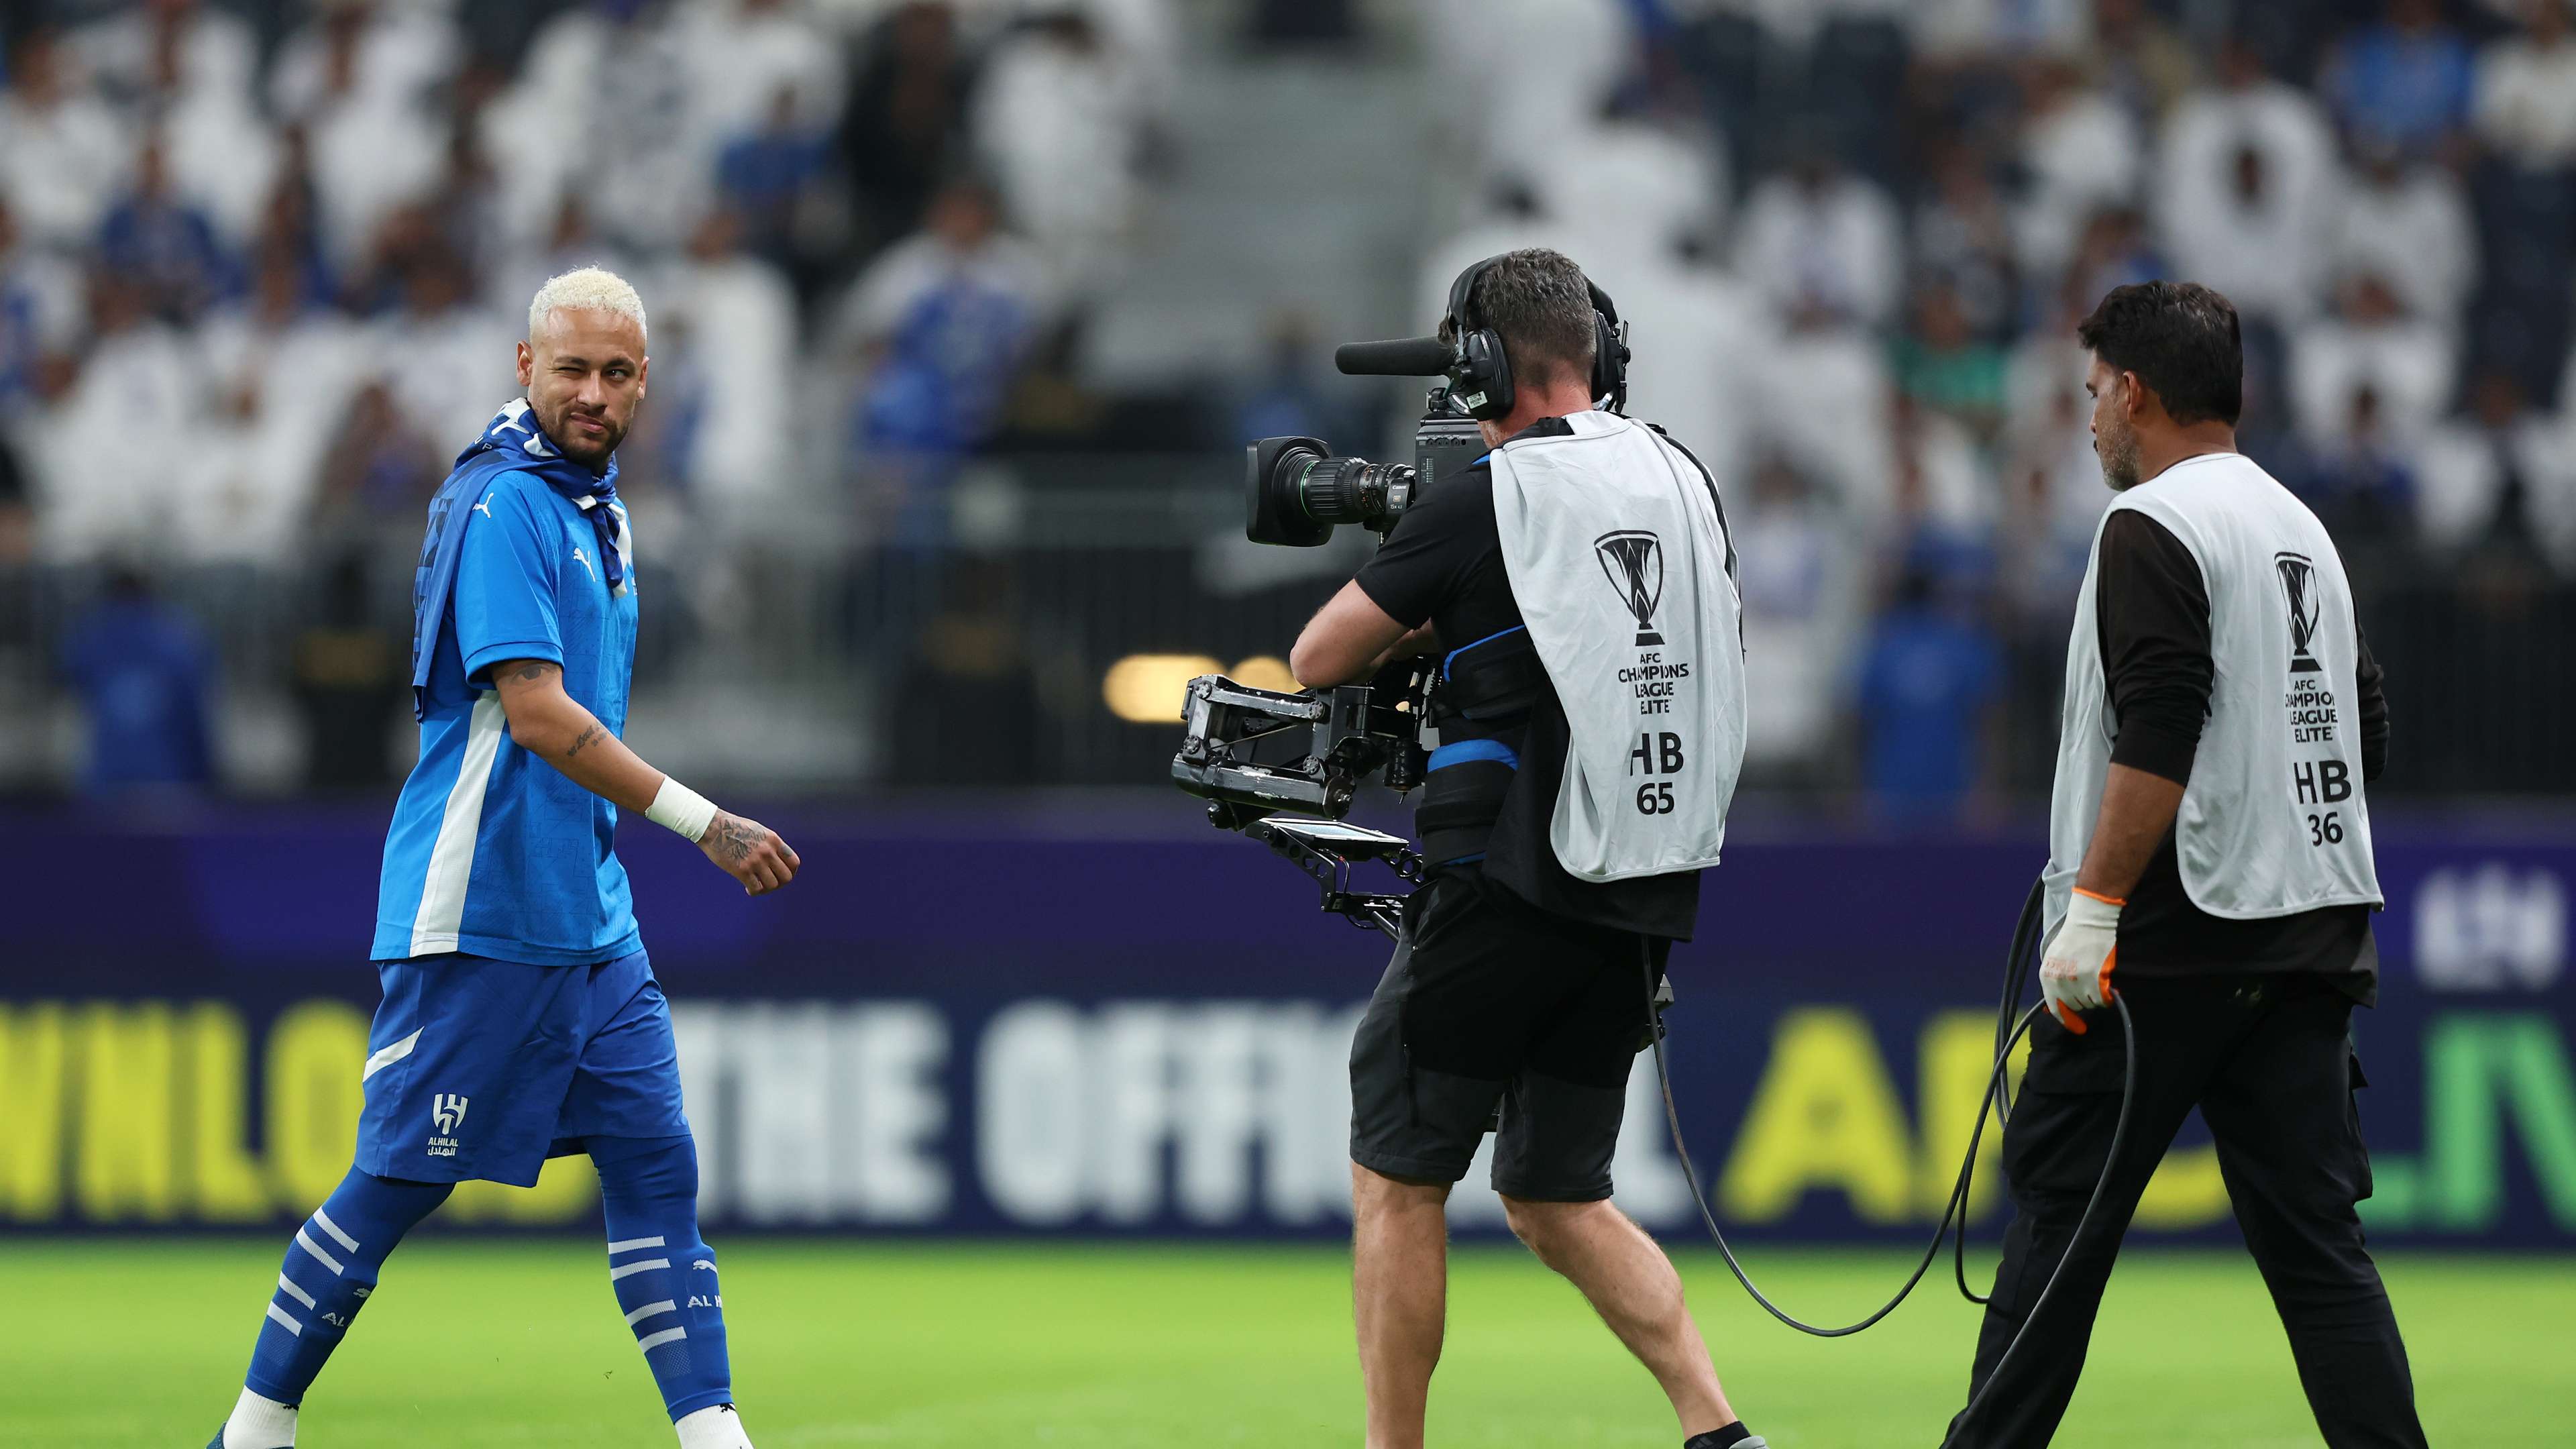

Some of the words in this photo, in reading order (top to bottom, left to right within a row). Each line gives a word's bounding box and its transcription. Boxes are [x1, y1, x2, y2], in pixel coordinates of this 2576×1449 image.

[1640, 653, 1661, 664] AFC
[1618, 663, 1689, 683] CHAMPIONS
[1635, 682, 1674, 698] LEAGUE
[2294, 680, 2316, 691] AFC
[2290, 709, 2338, 725] LEAGUE
[2295, 727, 2333, 743] ELITE
[1630, 732, 1684, 776] HB
[2294, 760, 2351, 804] HB
[1636, 782, 1674, 815] 65
[2308, 812, 2343, 847] 36
[688, 1295, 712, 1308] AL
